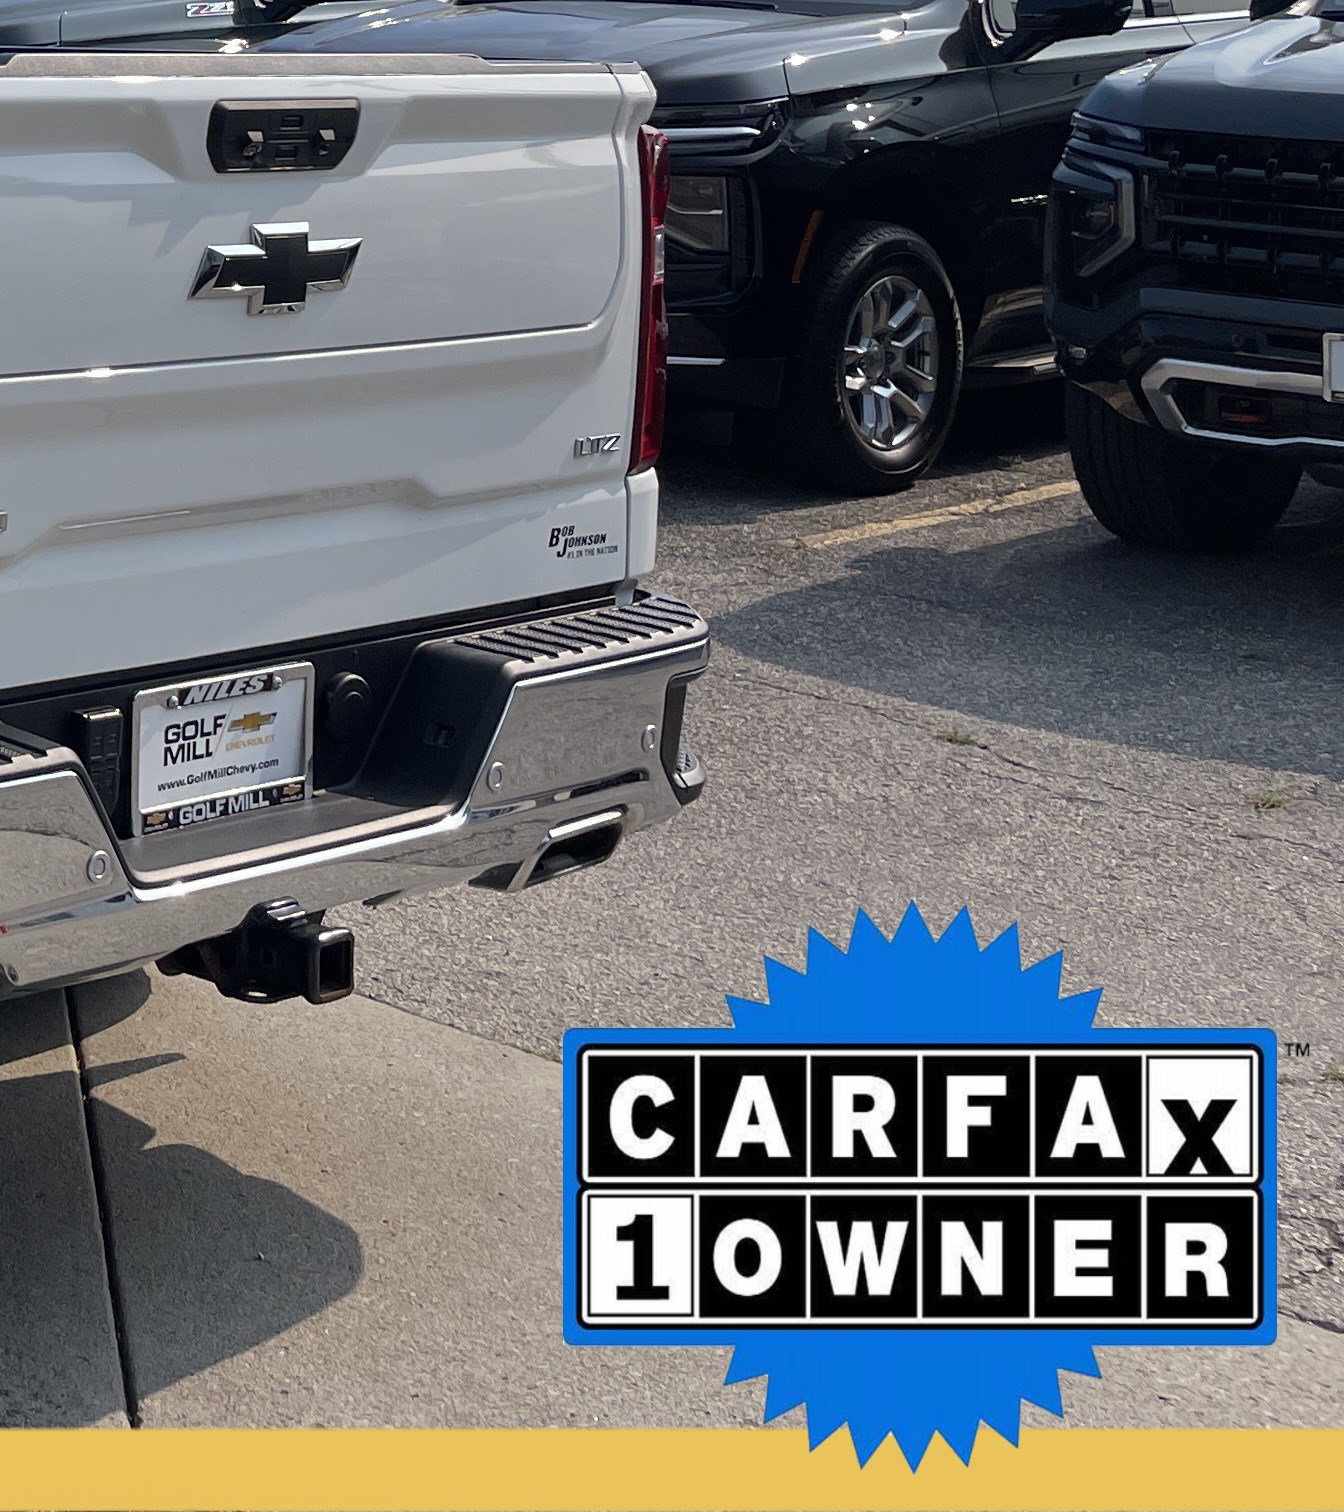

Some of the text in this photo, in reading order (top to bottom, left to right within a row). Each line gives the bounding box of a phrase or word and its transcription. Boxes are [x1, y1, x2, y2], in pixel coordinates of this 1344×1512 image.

[573, 432, 621, 459] LTZ
[548, 525, 575, 548] BOB
[556, 533, 607, 558] JOHNSON
[183, 674, 269, 705] NILES
[164, 713, 227, 744] GOLF
[163, 740, 214, 767] MILL
[225, 734, 276, 753] CHEVROLET
[157, 758, 279, 792] www.GolfMillChevy.com
[179, 791, 269, 825] GOLF MILL
